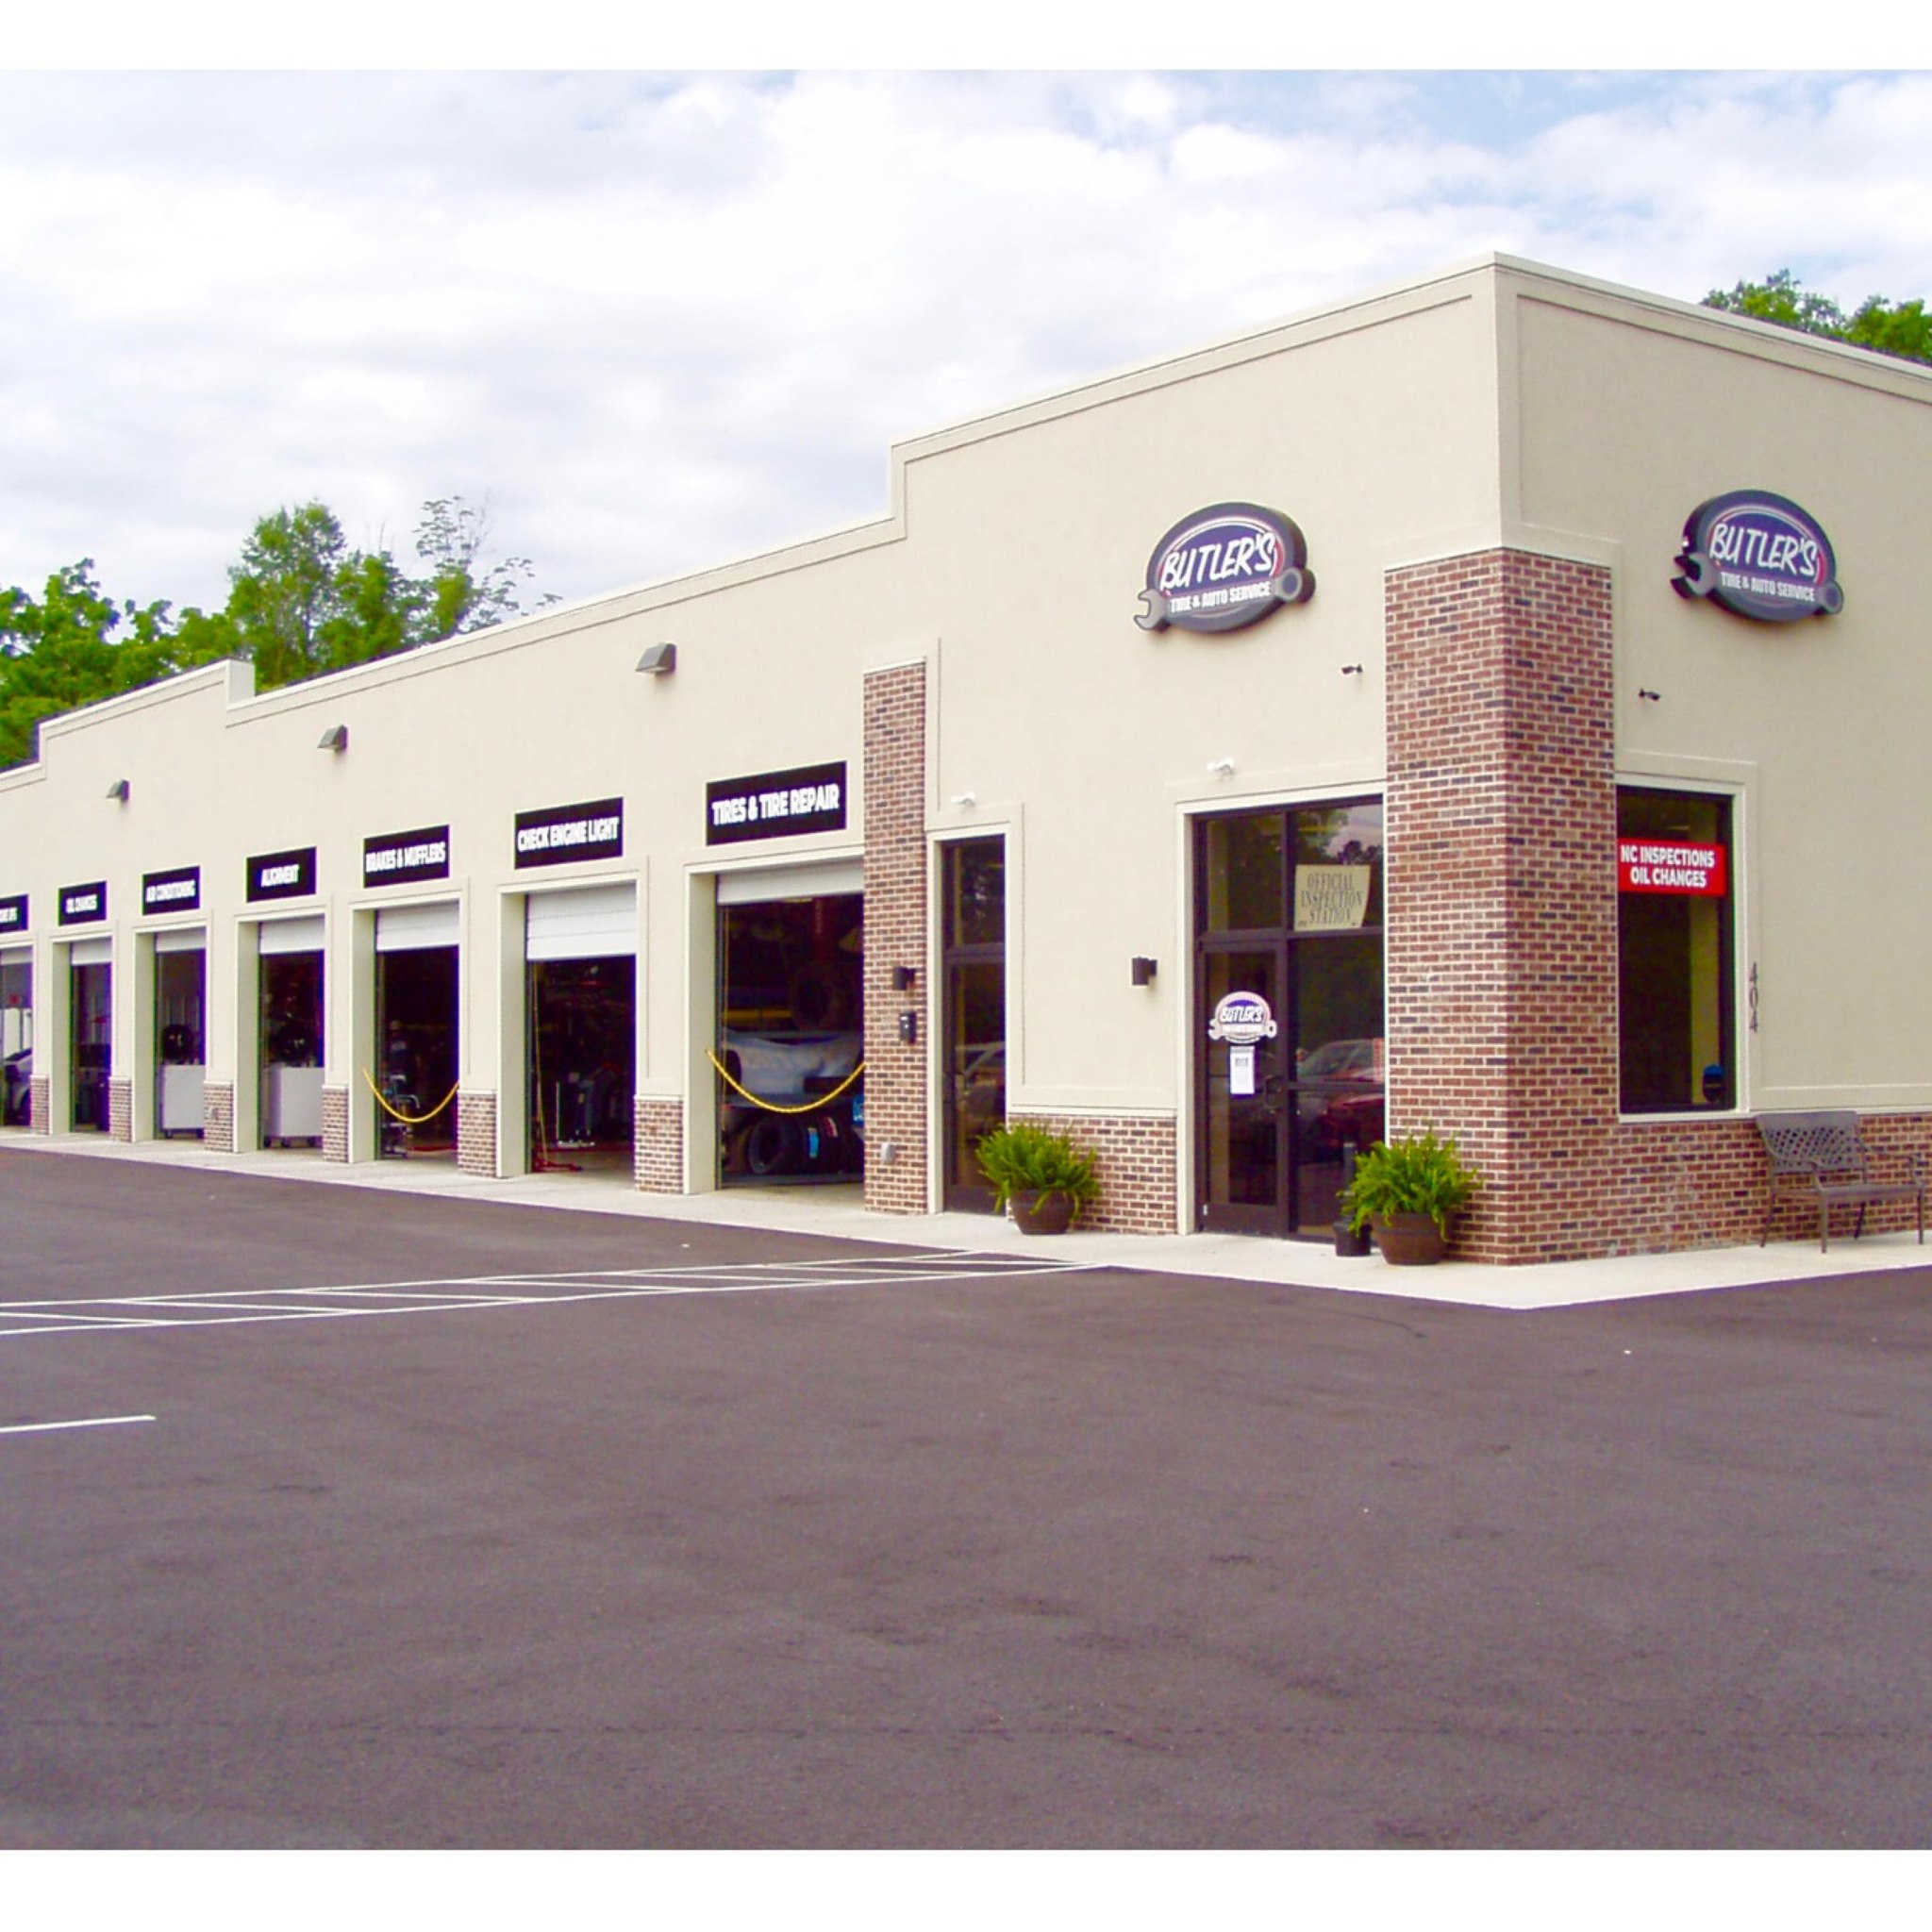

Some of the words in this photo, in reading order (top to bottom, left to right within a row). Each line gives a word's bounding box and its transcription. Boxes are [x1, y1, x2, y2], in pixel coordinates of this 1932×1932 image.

[1159, 531, 1275, 591] BUTLER'S
[1709, 523, 1818, 577] BUTLER'S
[1170, 597, 1191, 613] TIRE
[1192, 594, 1200, 608] &
[1202, 589, 1227, 608] AUTO
[1230, 581, 1272, 604] SERVICE
[1721, 571, 1740, 590] TIRE
[1742, 576, 1749, 589] &
[1751, 576, 1775, 595] AUTO
[1777, 581, 1815, 602] SERVICE
[711, 797, 746, 826] TIRES
[748, 795, 758, 822] &
[758, 791, 789, 819] TIRE
[790, 783, 840, 815] REPAIR
[518, 826, 549, 853] CHECK
[550, 820, 587, 848] ENGINE
[588, 816, 620, 843] LIGHT
[1620, 844, 1638, 863] NC
[1640, 845, 1715, 868] INSPECTIONS
[1307, 873, 1354, 891] OFFICIAL
[1630, 866, 1650, 885] OIL
[1652, 868, 1707, 889] CHANGES
[1301, 890, 1362, 908] INSPECTION
[1309, 907, 1350, 924] STATION
